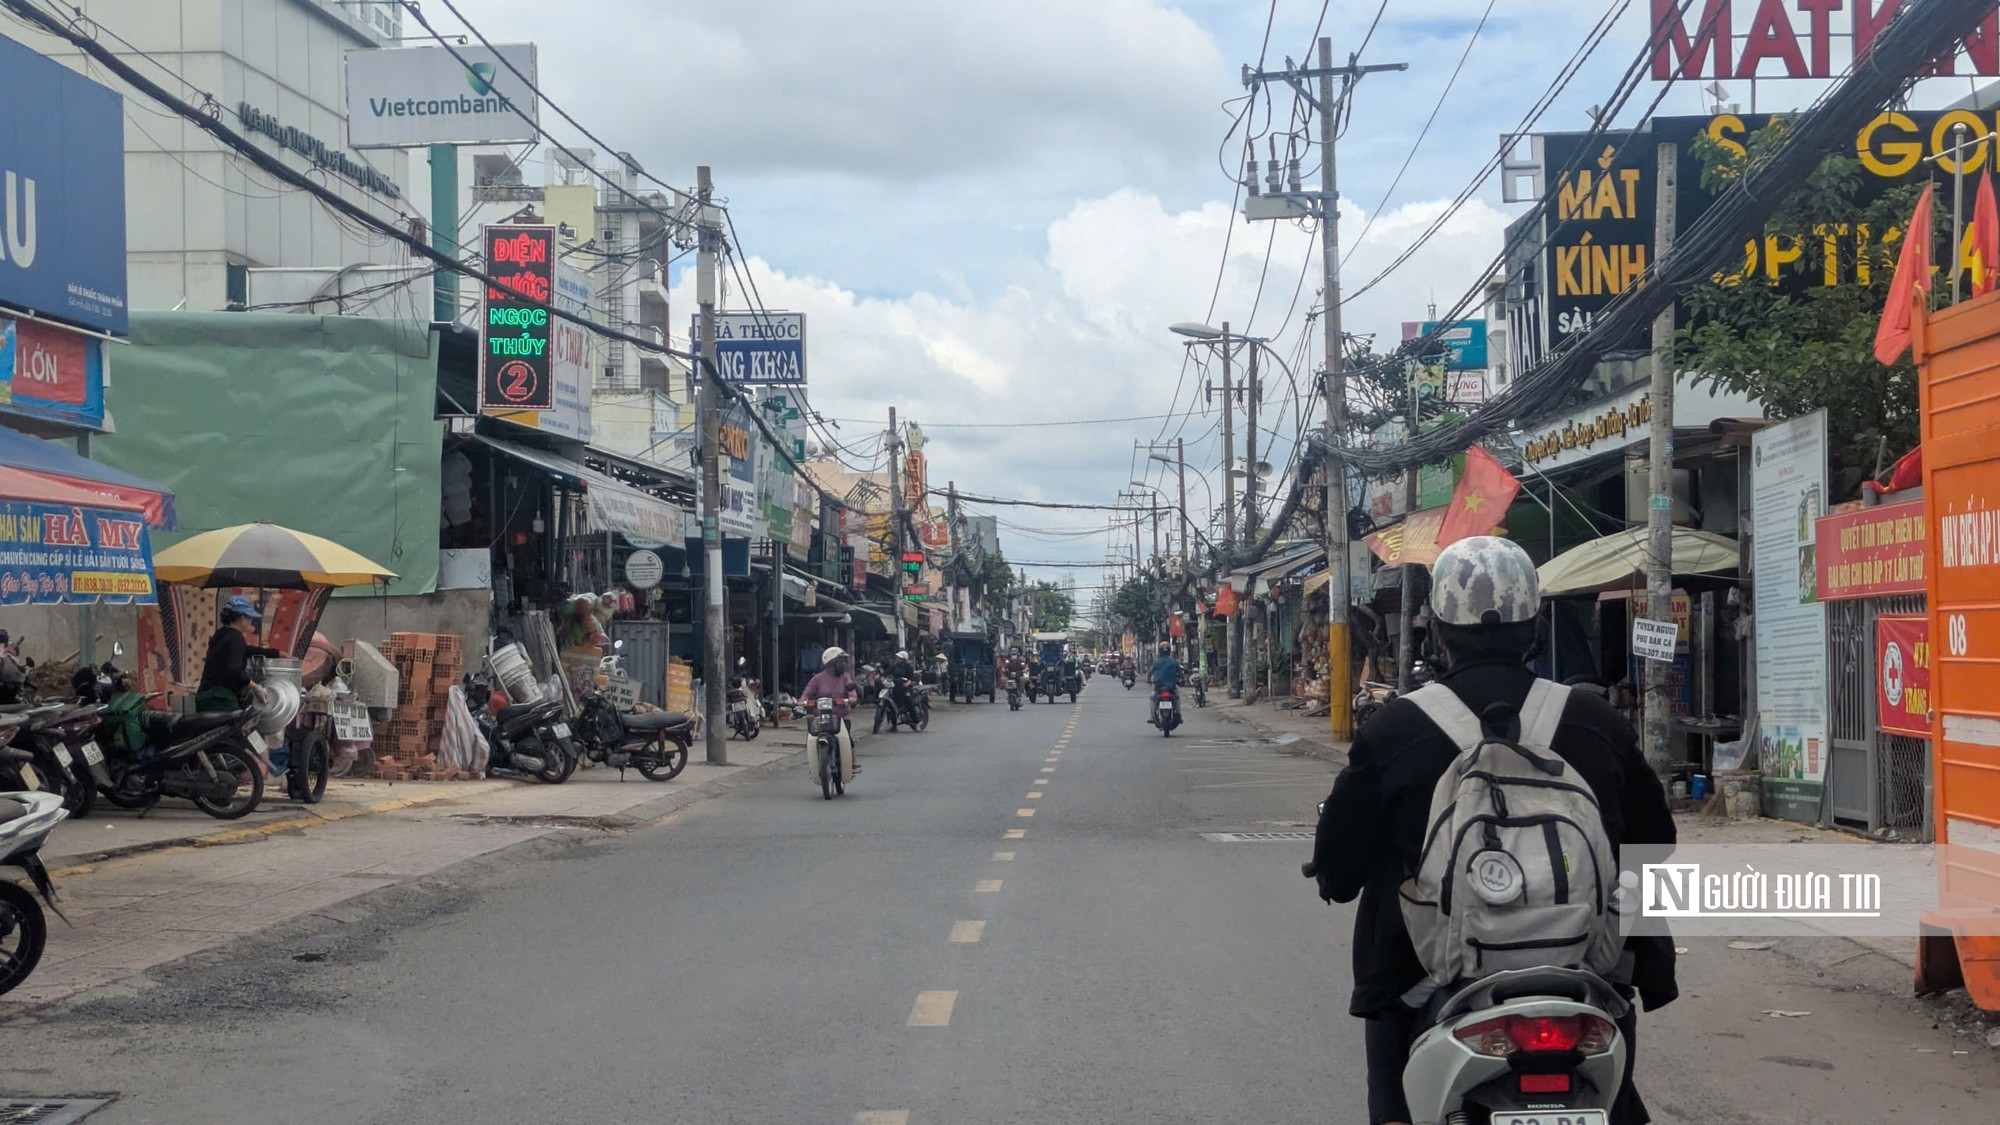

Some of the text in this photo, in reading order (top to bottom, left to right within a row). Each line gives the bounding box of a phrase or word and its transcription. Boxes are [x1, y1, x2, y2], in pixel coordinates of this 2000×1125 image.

[370, 94, 511, 117] Vietcombank
[1558, 145, 1640, 220] MẮT
[494, 233, 546, 267] ĐIỆN
[1556, 230, 1646, 296] KÍNH
[490, 308, 547, 328] NGỌC
[739, 318, 798, 339] THUỐC
[490, 333, 546, 355] THỦY
[23, 343, 58, 384] LỚN
[507, 364, 527, 395] 2
[750, 350, 801, 380] KHOA
[20, 505, 40, 543] SẢN
[43, 507, 90, 547] HÀ
[97, 519, 142, 550] MY
[1942, 502, 1958, 568] MÁY
[1960, 494, 1979, 567] BIẾN
[1981, 498, 1991, 565] ÁP
[1885, 560, 1892, 583] 17
[1949, 614, 1967, 656] 08
